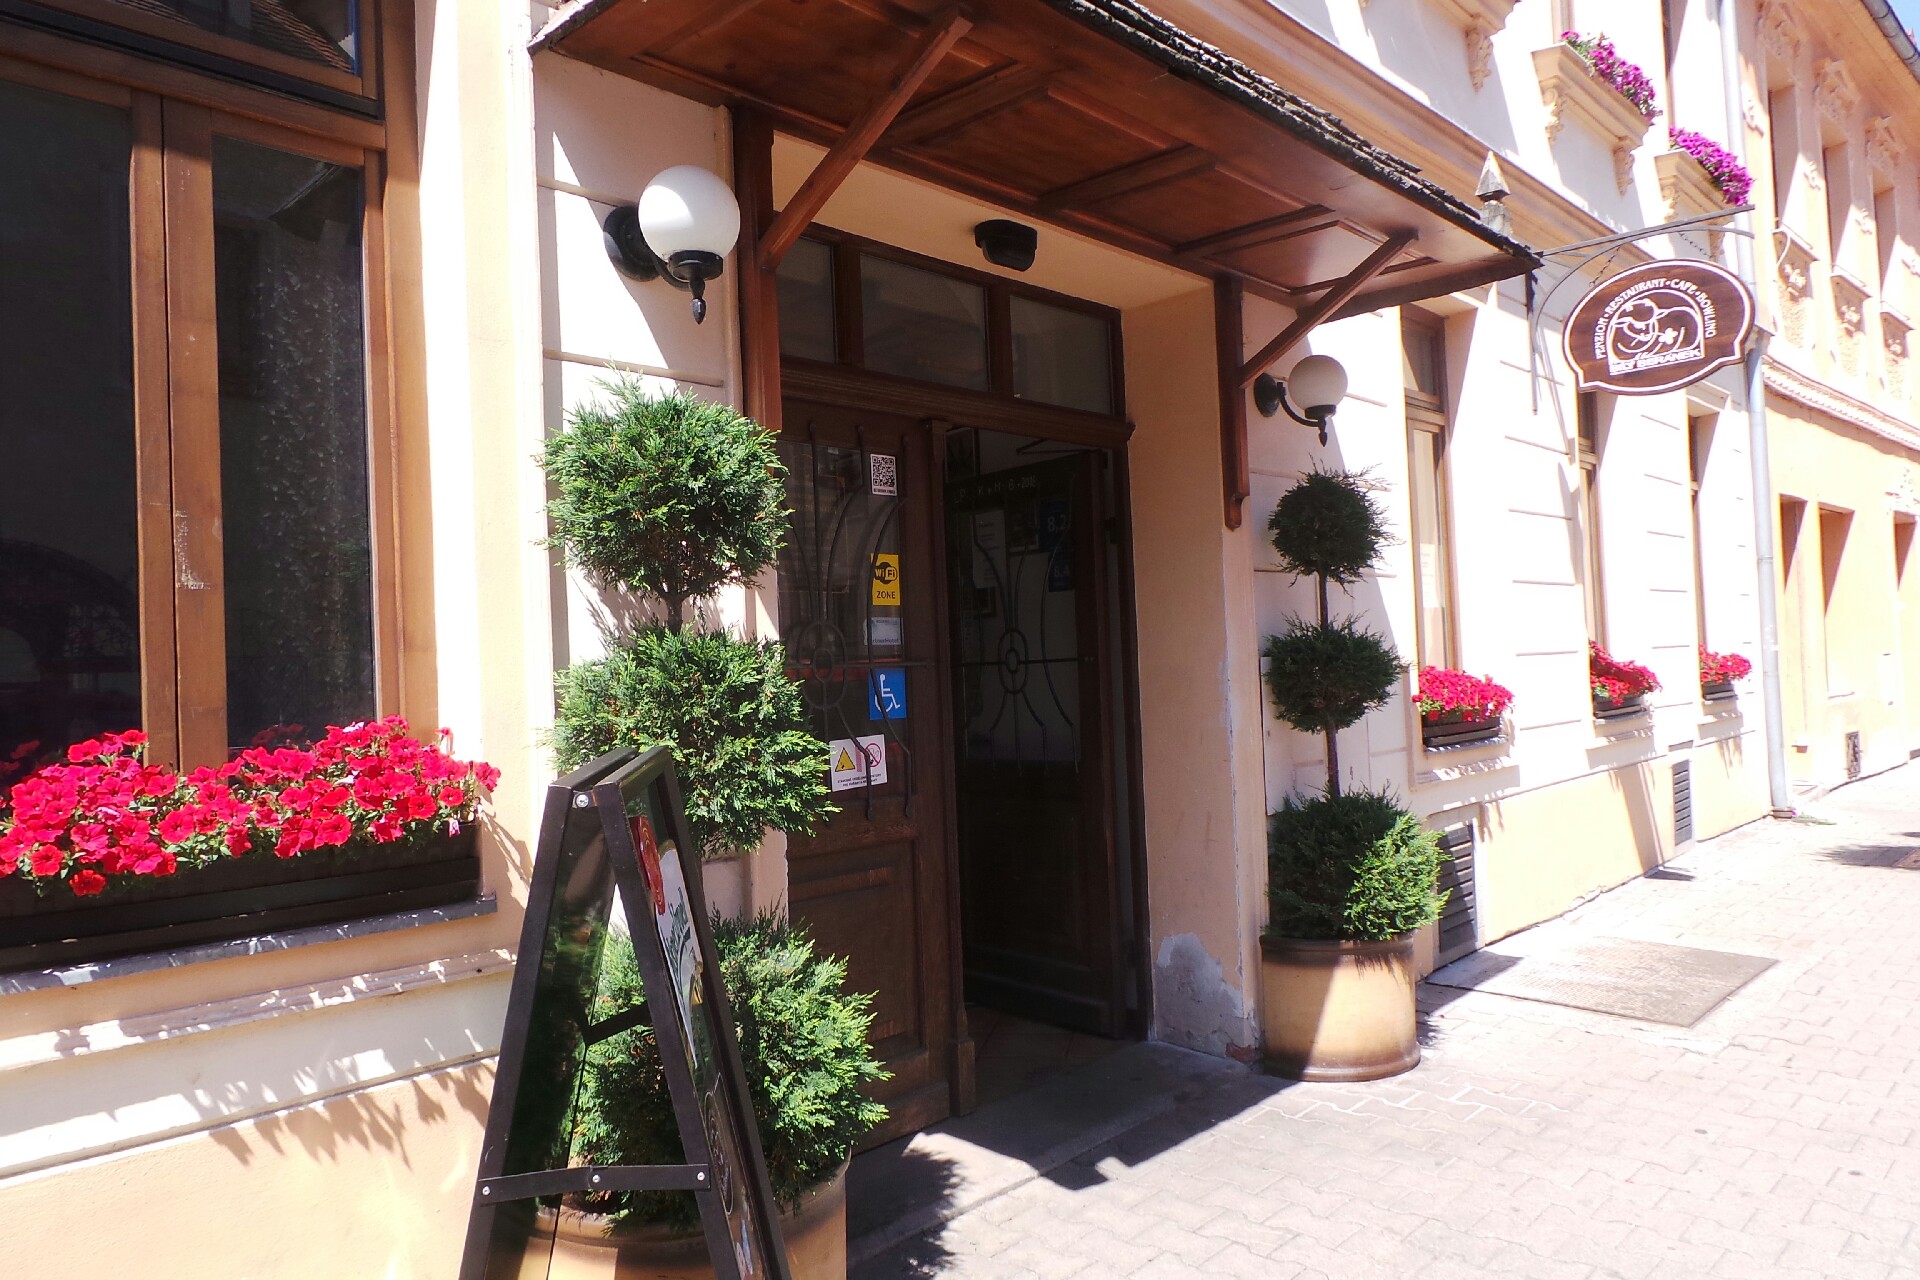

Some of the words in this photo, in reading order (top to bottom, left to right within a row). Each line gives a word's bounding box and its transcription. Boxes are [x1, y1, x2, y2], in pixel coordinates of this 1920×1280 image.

[1594, 317, 1609, 360] PENZION
[1607, 278, 1667, 315] RESTAURANT
[1696, 292, 1717, 338] BOWLING
[876, 590, 896, 600] ZONE
